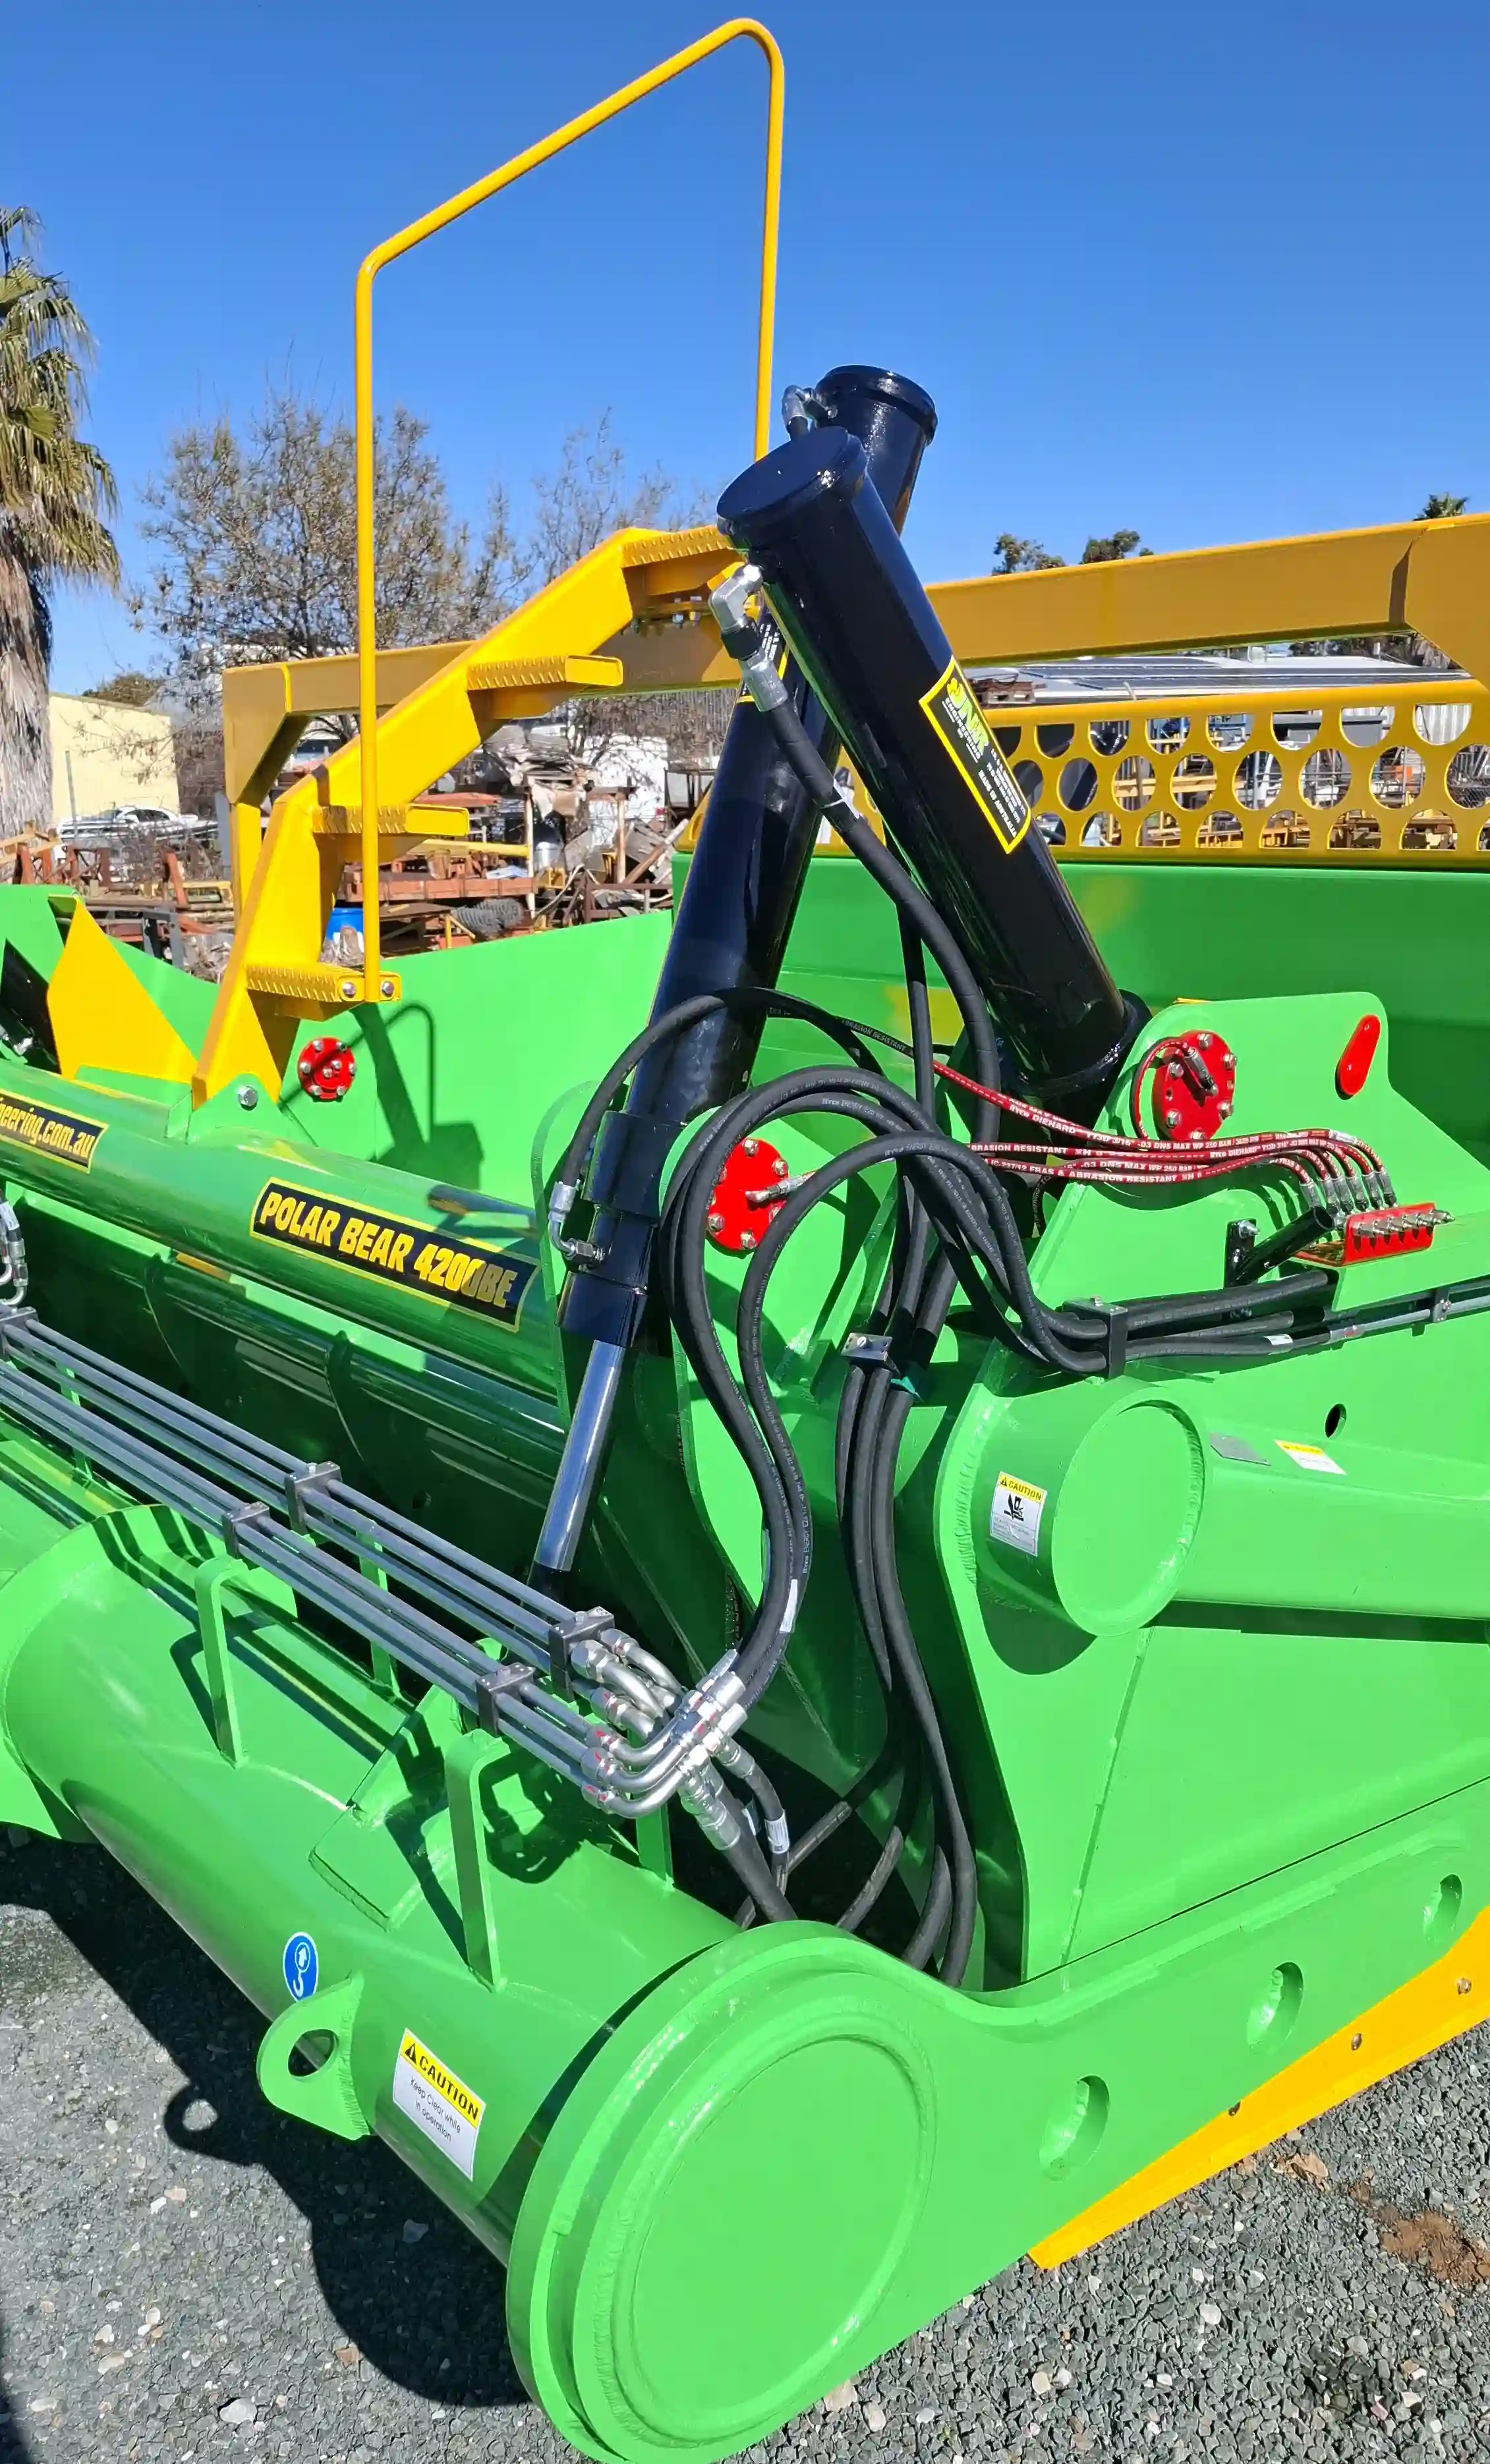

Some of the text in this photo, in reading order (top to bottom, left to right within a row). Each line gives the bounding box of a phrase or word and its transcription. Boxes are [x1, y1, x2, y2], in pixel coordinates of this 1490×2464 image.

[945, 697, 981, 759] ENGINEERING
[1014, 1144, 1068, 1154] RESISTANT
[1068, 1170, 1124, 1182] ABRASION
[1125, 1174, 1177, 1183] RESISTANT
[260, 1192, 518, 1308] POLAR BEAR 4200BE
[1008, 1480, 1042, 1501] CAUTION
[410, 2075, 461, 2133] Keep Clear while
[418, 2055, 479, 2121] CAUTION
[421, 2107, 452, 2142] operation
